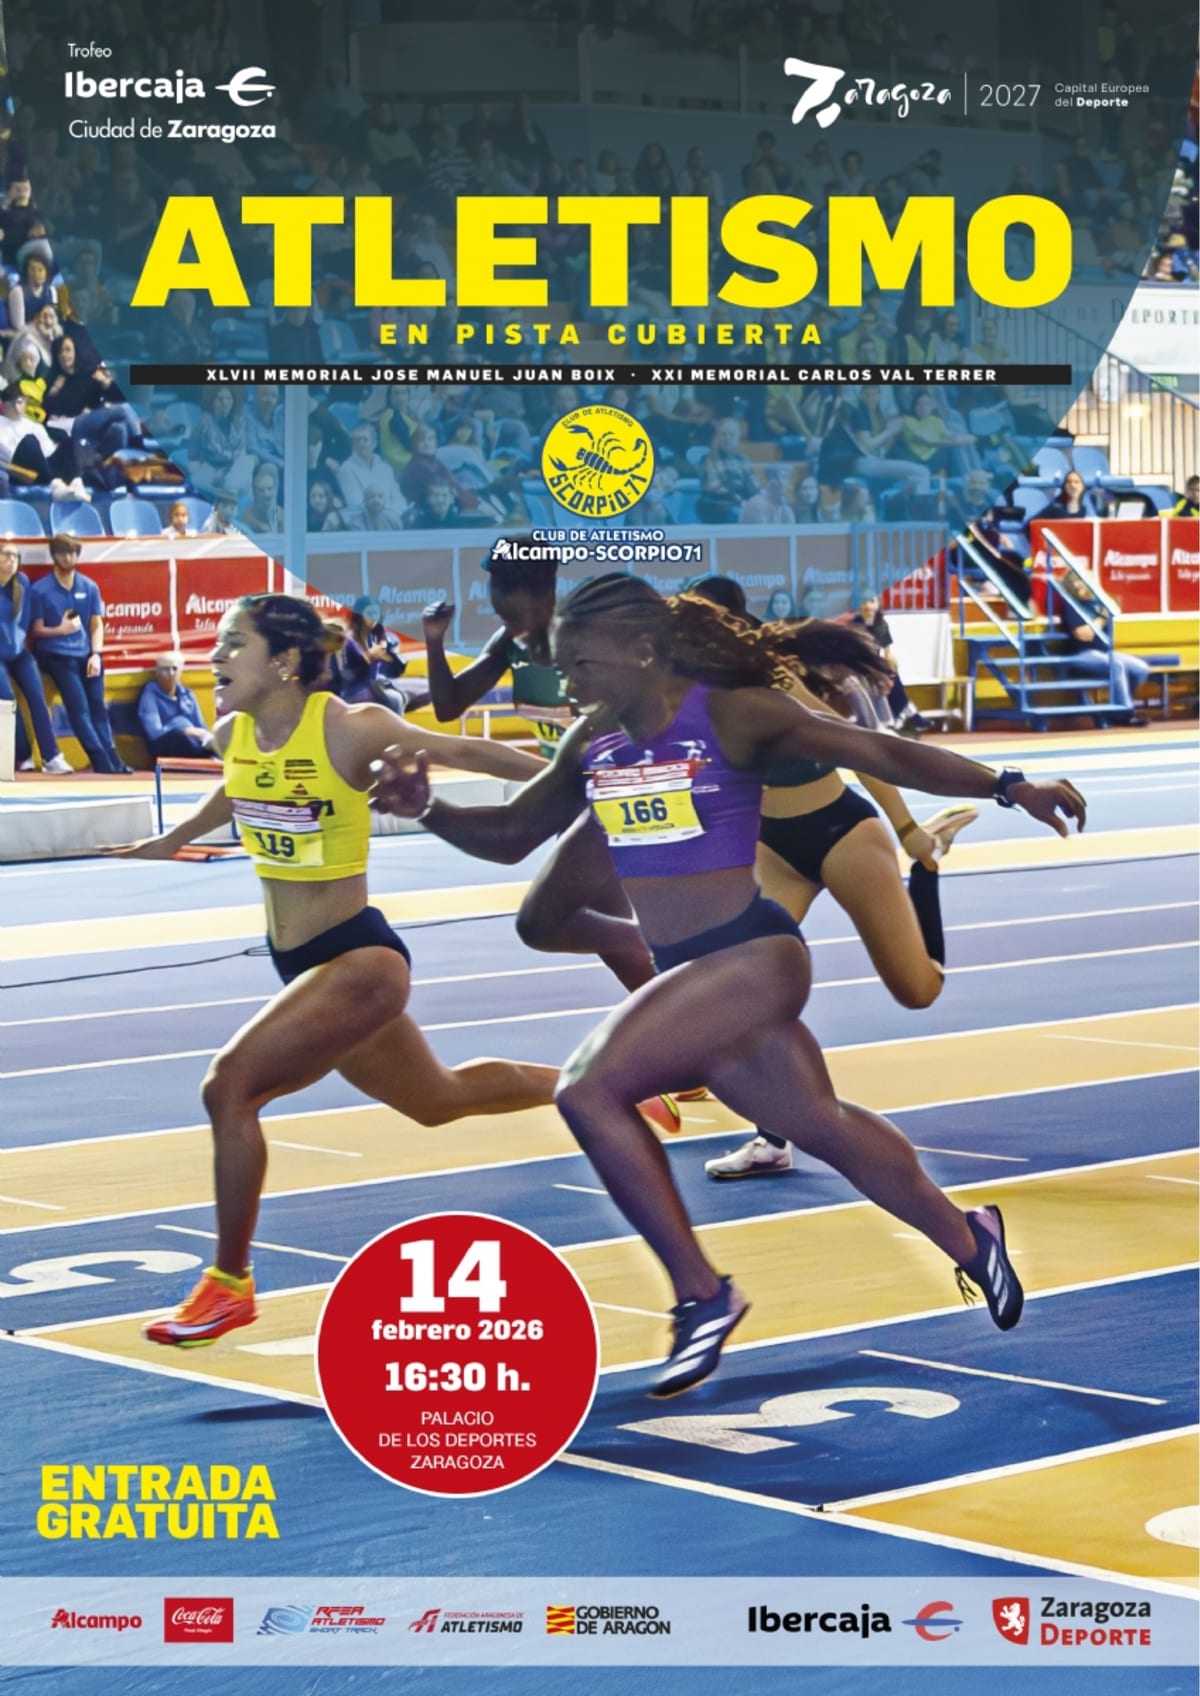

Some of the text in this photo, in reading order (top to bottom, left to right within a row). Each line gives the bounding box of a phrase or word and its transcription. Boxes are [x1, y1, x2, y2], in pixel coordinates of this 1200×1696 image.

[101, 602, 163, 619] lcampo
[619, 797, 668, 825] 166
[253, 831, 296, 858] 119
